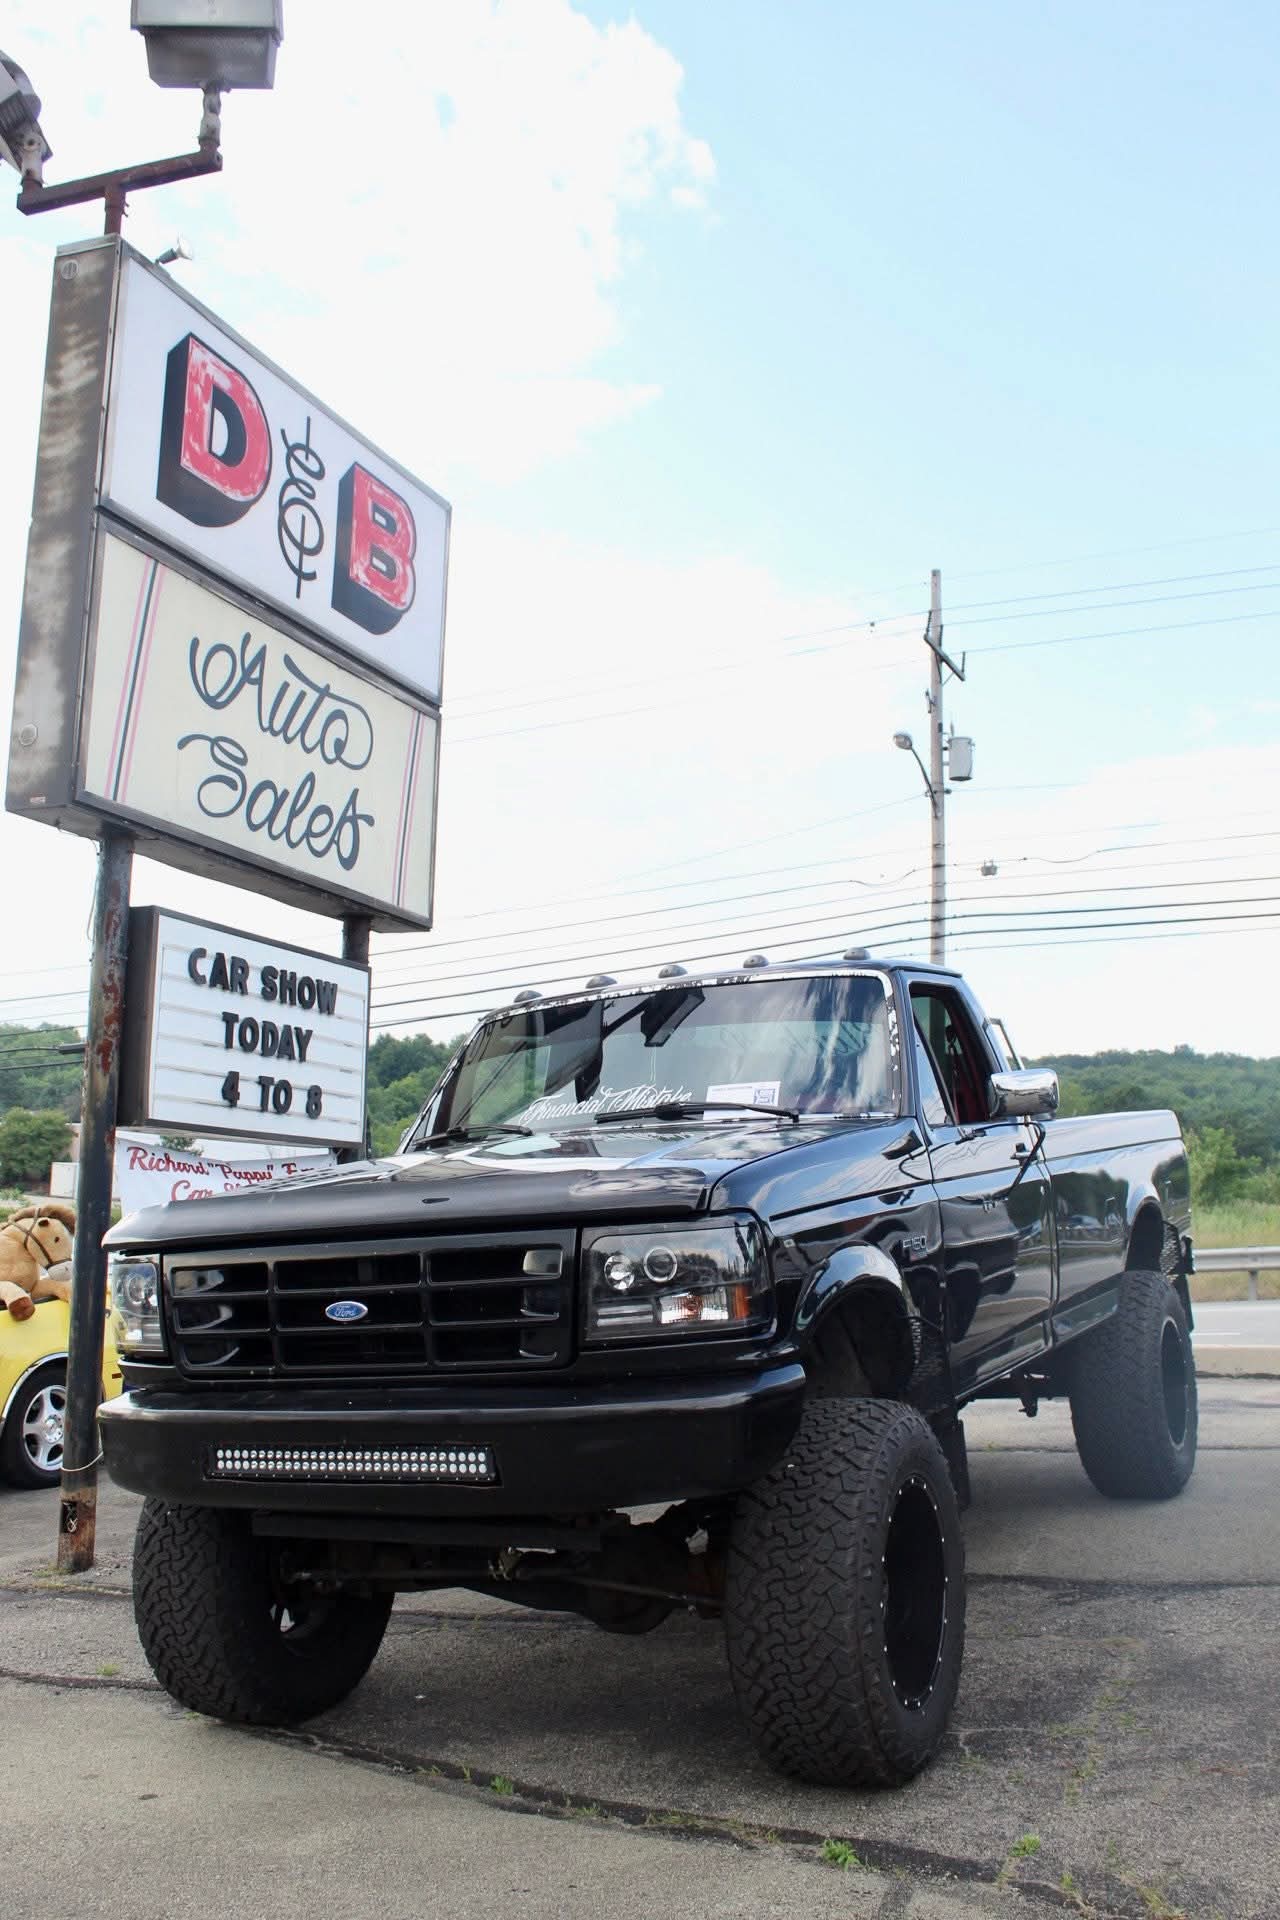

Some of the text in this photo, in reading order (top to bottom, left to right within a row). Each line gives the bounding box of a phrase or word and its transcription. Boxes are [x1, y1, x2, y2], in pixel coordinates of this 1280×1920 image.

[157, 332, 272, 528] D
[331, 462, 417, 635] B
[189, 632, 374, 770] Auto
[177, 734, 375, 871] Sales
[188, 947, 338, 1015] CAR SHOW
[222, 1011, 313, 1063] TODAY
[221, 1070, 323, 1119] 4 TO 8
[519, 1083, 692, 1127] Financial Mistake
[127, 1146, 209, 1176] Richard
